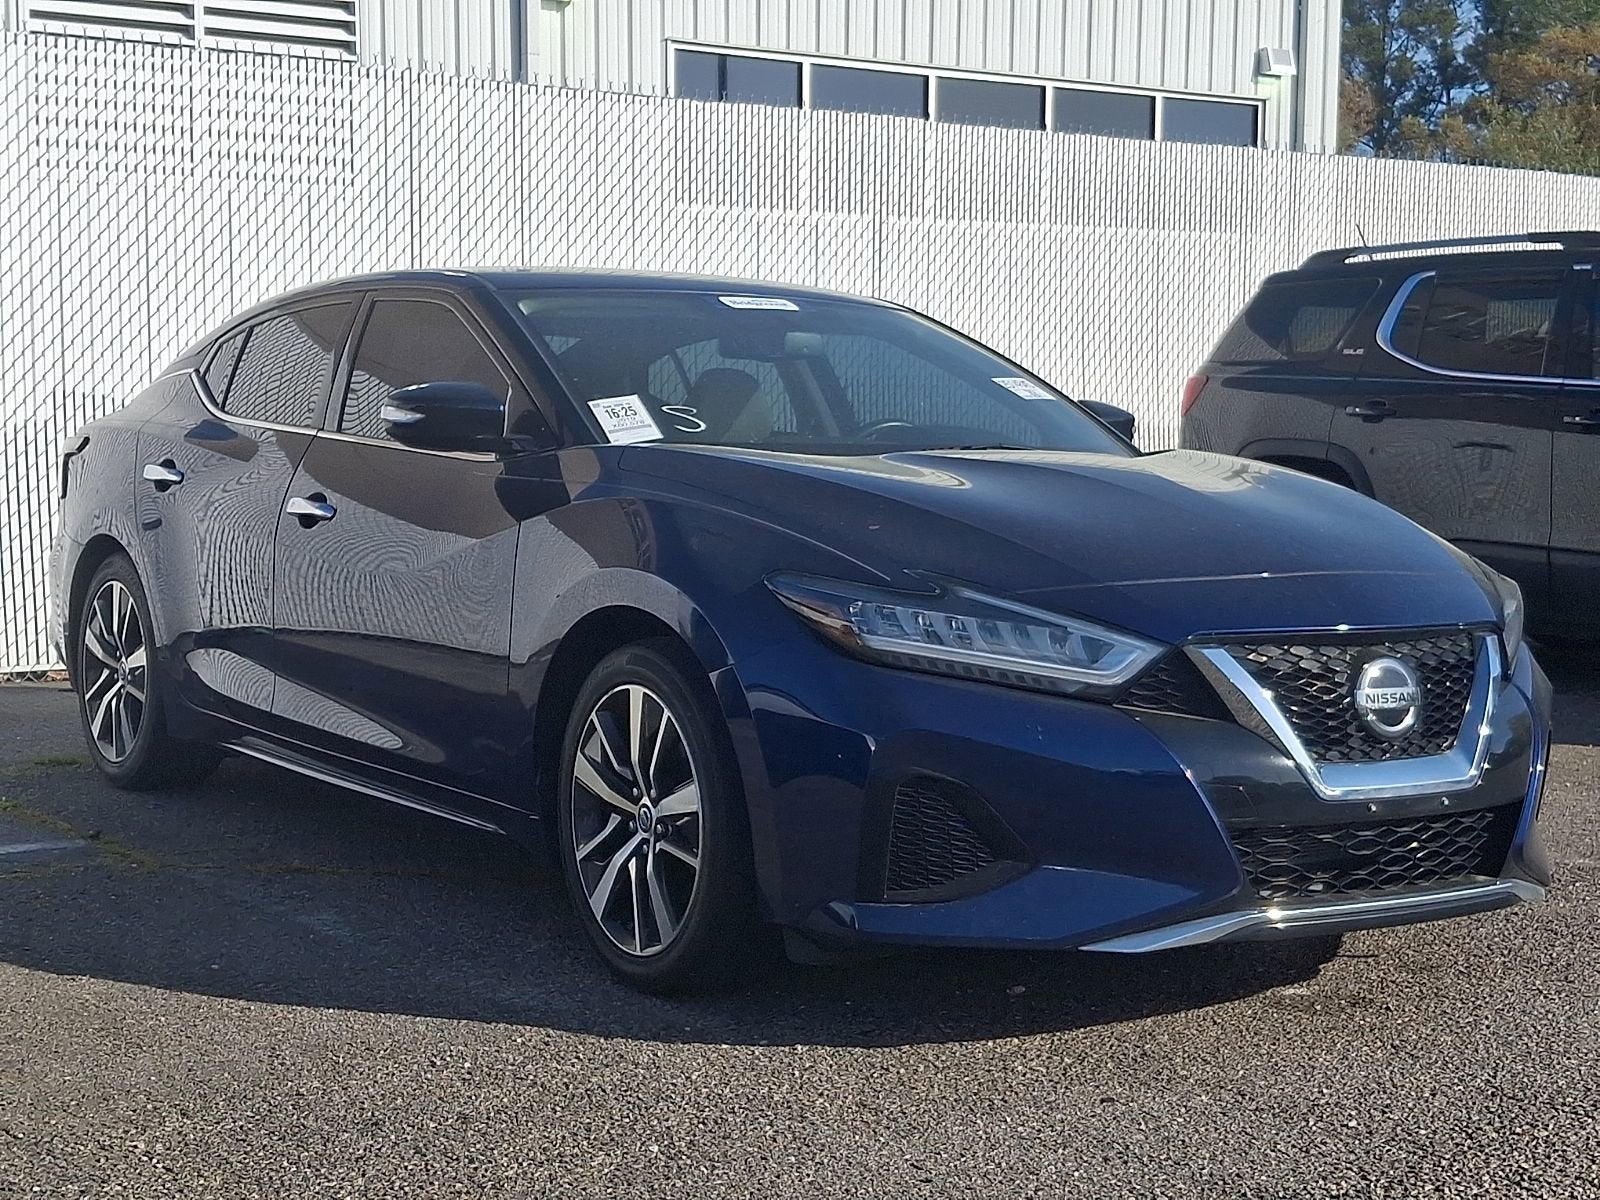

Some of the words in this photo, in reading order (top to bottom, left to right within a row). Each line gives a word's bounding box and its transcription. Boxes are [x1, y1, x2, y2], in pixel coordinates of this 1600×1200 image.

[605, 406, 637, 419] 16:25
[661, 405, 706, 432] S
[1365, 692, 1414, 704] NISSAN
